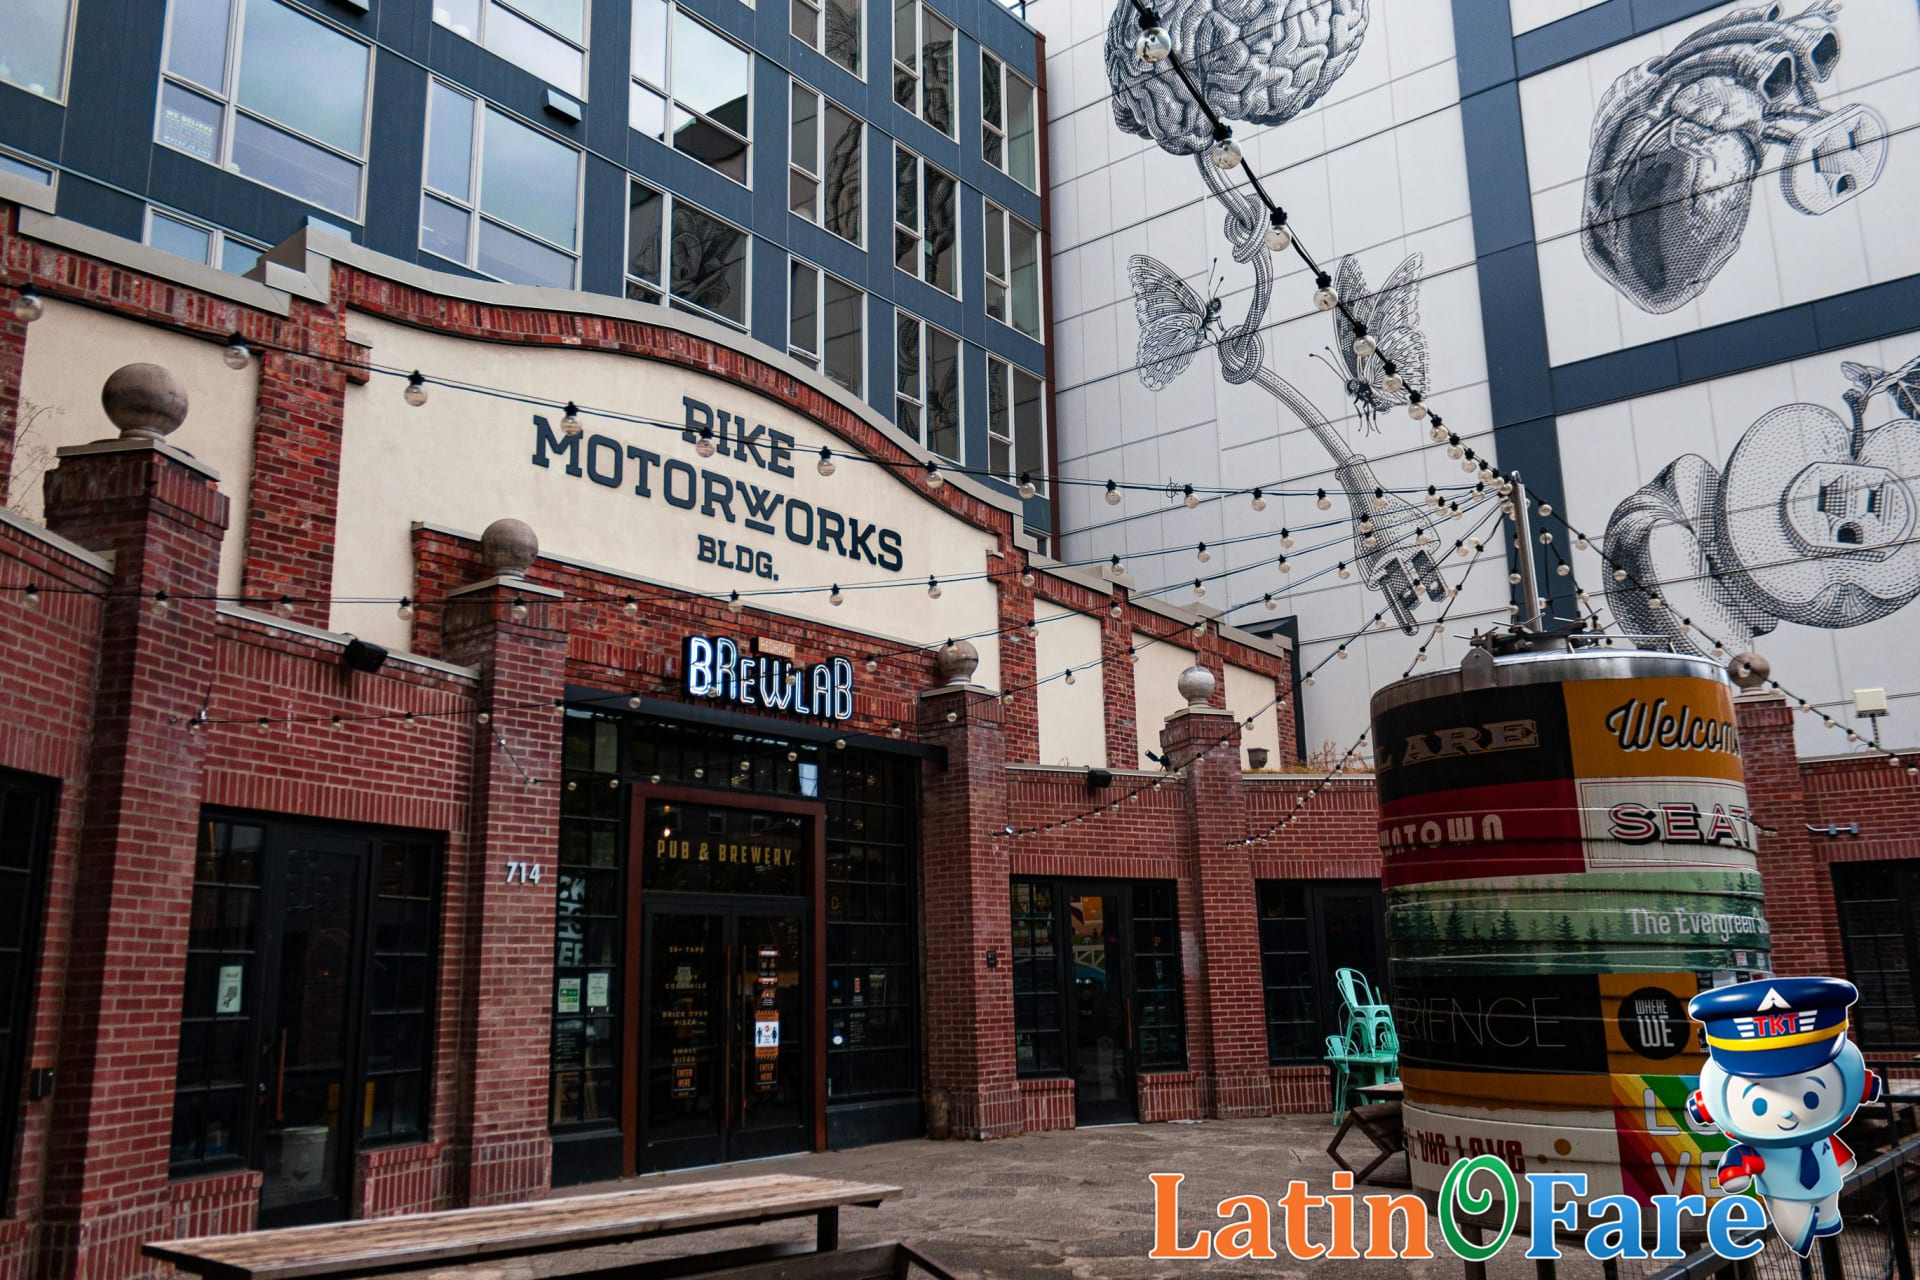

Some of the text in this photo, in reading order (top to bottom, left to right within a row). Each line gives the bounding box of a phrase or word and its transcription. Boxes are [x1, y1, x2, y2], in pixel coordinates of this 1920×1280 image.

[682, 396, 795, 478] PIKE
[531, 414, 903, 573] MOTORWORKS
[697, 533, 779, 581] BLDG.
[1401, 718, 1540, 768] ARE
[657, 839, 792, 866] PUB & BREWERY
[506, 861, 542, 885] 714
[1626, 907, 1672, 935] The
[1674, 907, 1756, 942] Evergreen
[1634, 999, 1668, 1015] WHERE
[1637, 1015, 1675, 1048] WE
